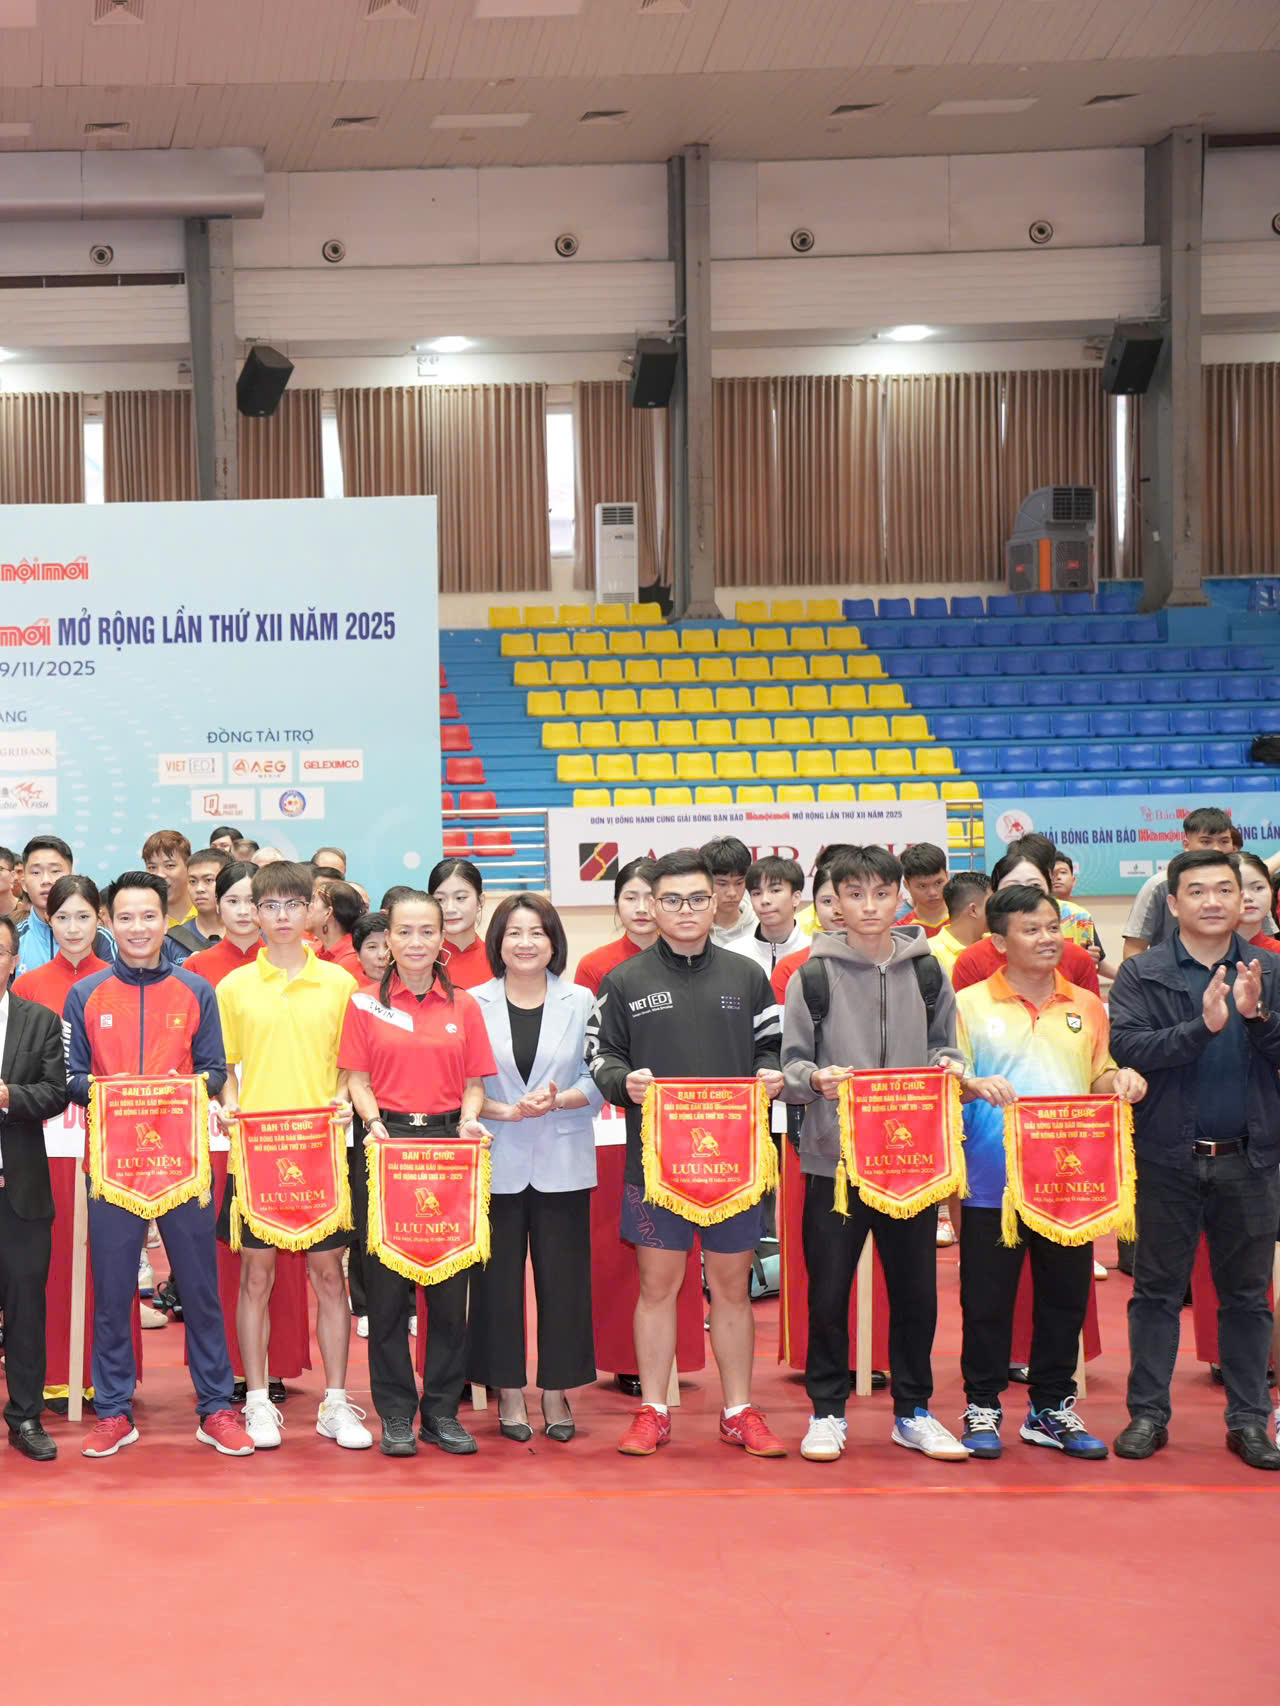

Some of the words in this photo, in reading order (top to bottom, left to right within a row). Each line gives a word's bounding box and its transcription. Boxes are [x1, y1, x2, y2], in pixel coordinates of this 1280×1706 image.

[58, 607, 91, 647] MỞ
[98, 610, 155, 652] RỘNG
[162, 604, 203, 645] LẦN
[209, 607, 251, 644] THỨ
[255, 612, 282, 643] XII
[290, 606, 339, 642] NĂM
[345, 611, 396, 641] 2025
[206, 727, 253, 744] ĐỒNG
[256, 728, 280, 743] TÀI
[283, 728, 314, 745] TRỢ
[165, 760, 186, 772] VIET
[250, 761, 286, 773] AEG
[303, 760, 360, 770] GELEXIMCO
[31, 801, 49, 809] FISH
[885, 811, 903, 819] 2025
[1061, 828, 1089, 845] BÓNG
[1092, 826, 1113, 844] BÀN
[1116, 826, 1137, 843] BÁO
[628, 998, 647, 1012] VIET
[871, 1083, 888, 1092] BAN
[902, 1080, 925, 1090] CHỨC
[261, 1123, 278, 1132] BAN
[291, 1121, 313, 1131] CHỨC
[402, 1152, 420, 1160] BAN
[433, 1150, 455, 1160] CHỨC
[865, 1156, 894, 1167] LƯU
[897, 1153, 934, 1166] NIỆM
[117, 1158, 145, 1169] LƯU
[147, 1155, 182, 1168] NIỆM
[672, 1164, 701, 1175] LƯU
[704, 1162, 739, 1175] NIỆM
[1035, 1183, 1064, 1194] LƯU
[1066, 1180, 1104, 1194] NIỆM
[260, 1192, 288, 1203] LƯU
[289, 1189, 325, 1203] NIỆM
[395, 1222, 423, 1233] LƯU
[426, 1221, 460, 1234] NIỆM
